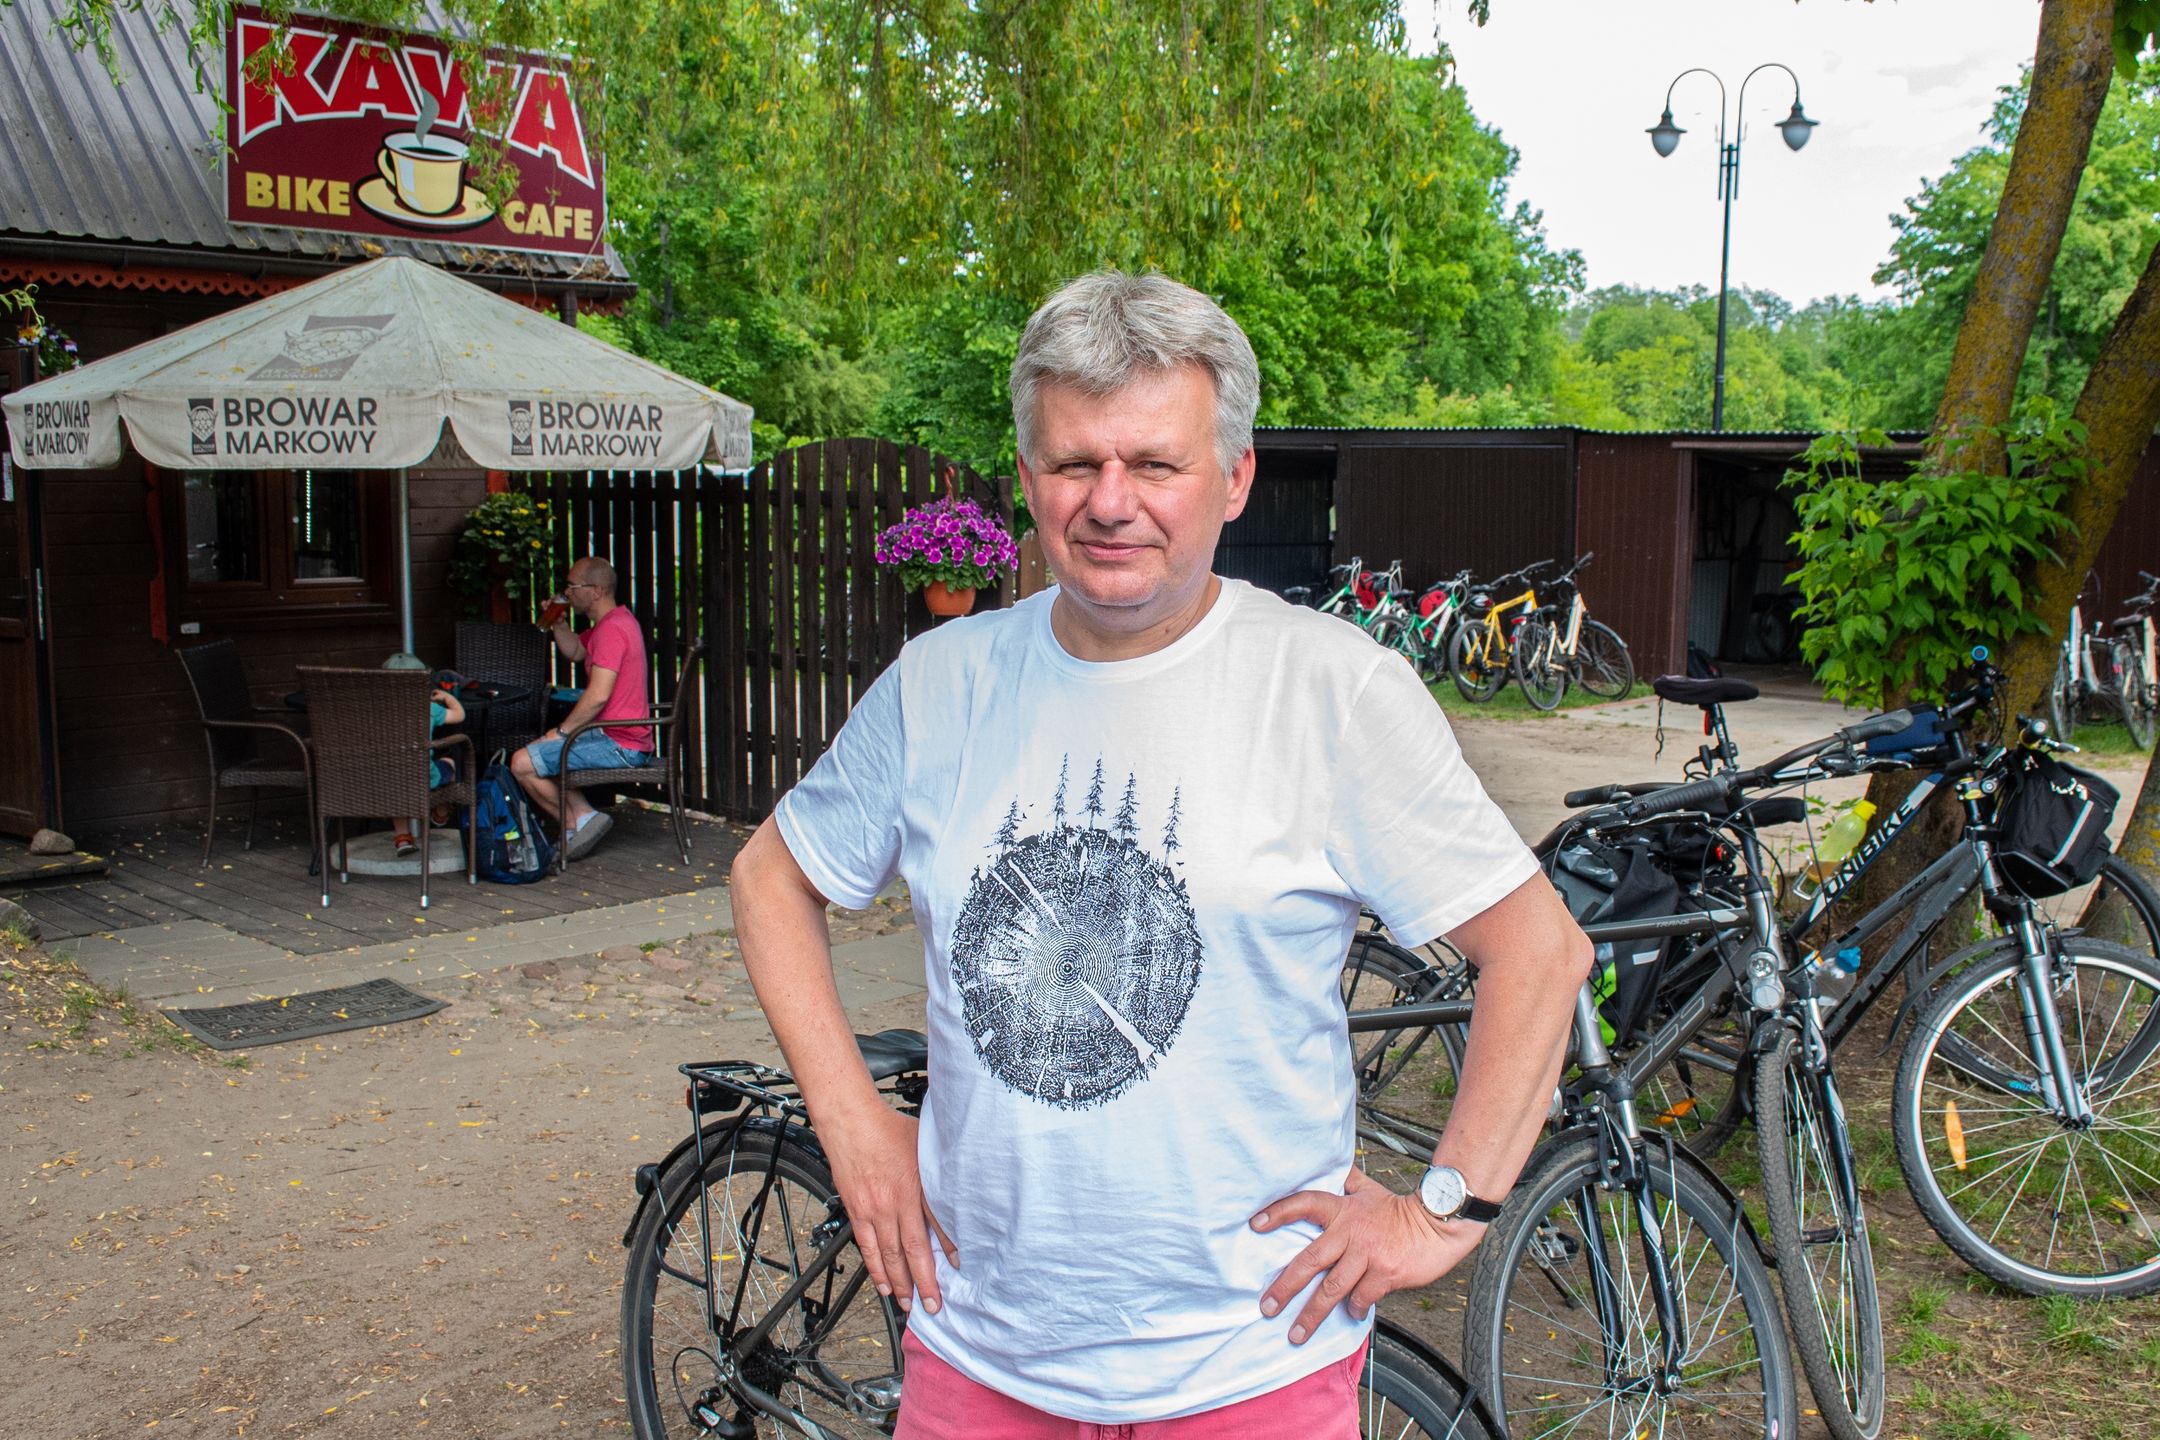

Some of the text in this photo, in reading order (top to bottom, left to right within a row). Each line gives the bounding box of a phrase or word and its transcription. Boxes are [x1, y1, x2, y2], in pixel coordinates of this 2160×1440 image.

[237, 18, 596, 189] KAWA
[245, 172, 351, 216] BIKE
[502, 201, 594, 240] CAFE
[36, 400, 91, 430] BROWAR
[223, 397, 378, 427] BROWAR
[539, 401, 664, 432] BROWAR
[36, 431, 91, 456] MARKOWY
[225, 430, 378, 454] MARKOWY
[540, 434, 663, 457] MARKOWY
